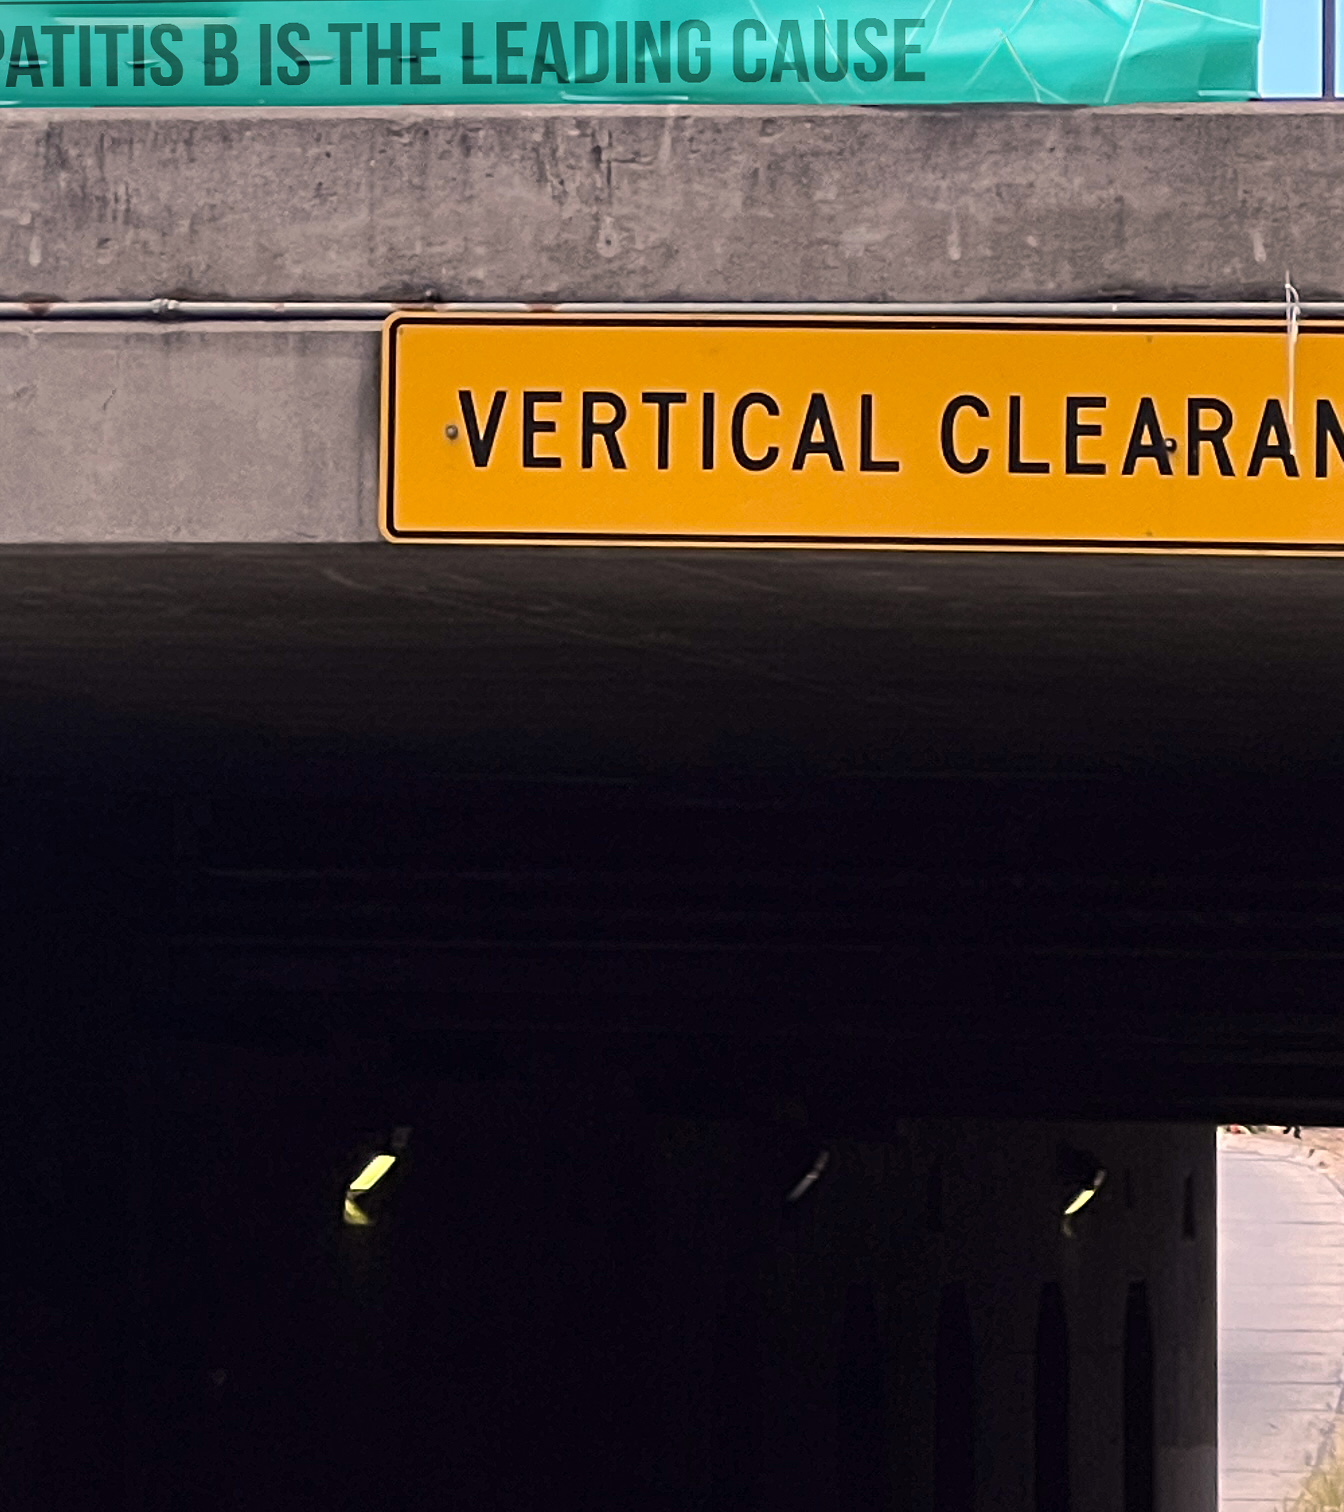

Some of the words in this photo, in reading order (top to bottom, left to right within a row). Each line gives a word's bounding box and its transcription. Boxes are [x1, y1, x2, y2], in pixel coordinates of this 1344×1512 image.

[202, 23, 240, 88] B
[258, 21, 312, 87] IS
[327, 21, 442, 87] THE
[460, 19, 712, 86] LEADING
[730, 17, 927, 85] CAUSE
[456, 389, 902, 475] VERTICAL
